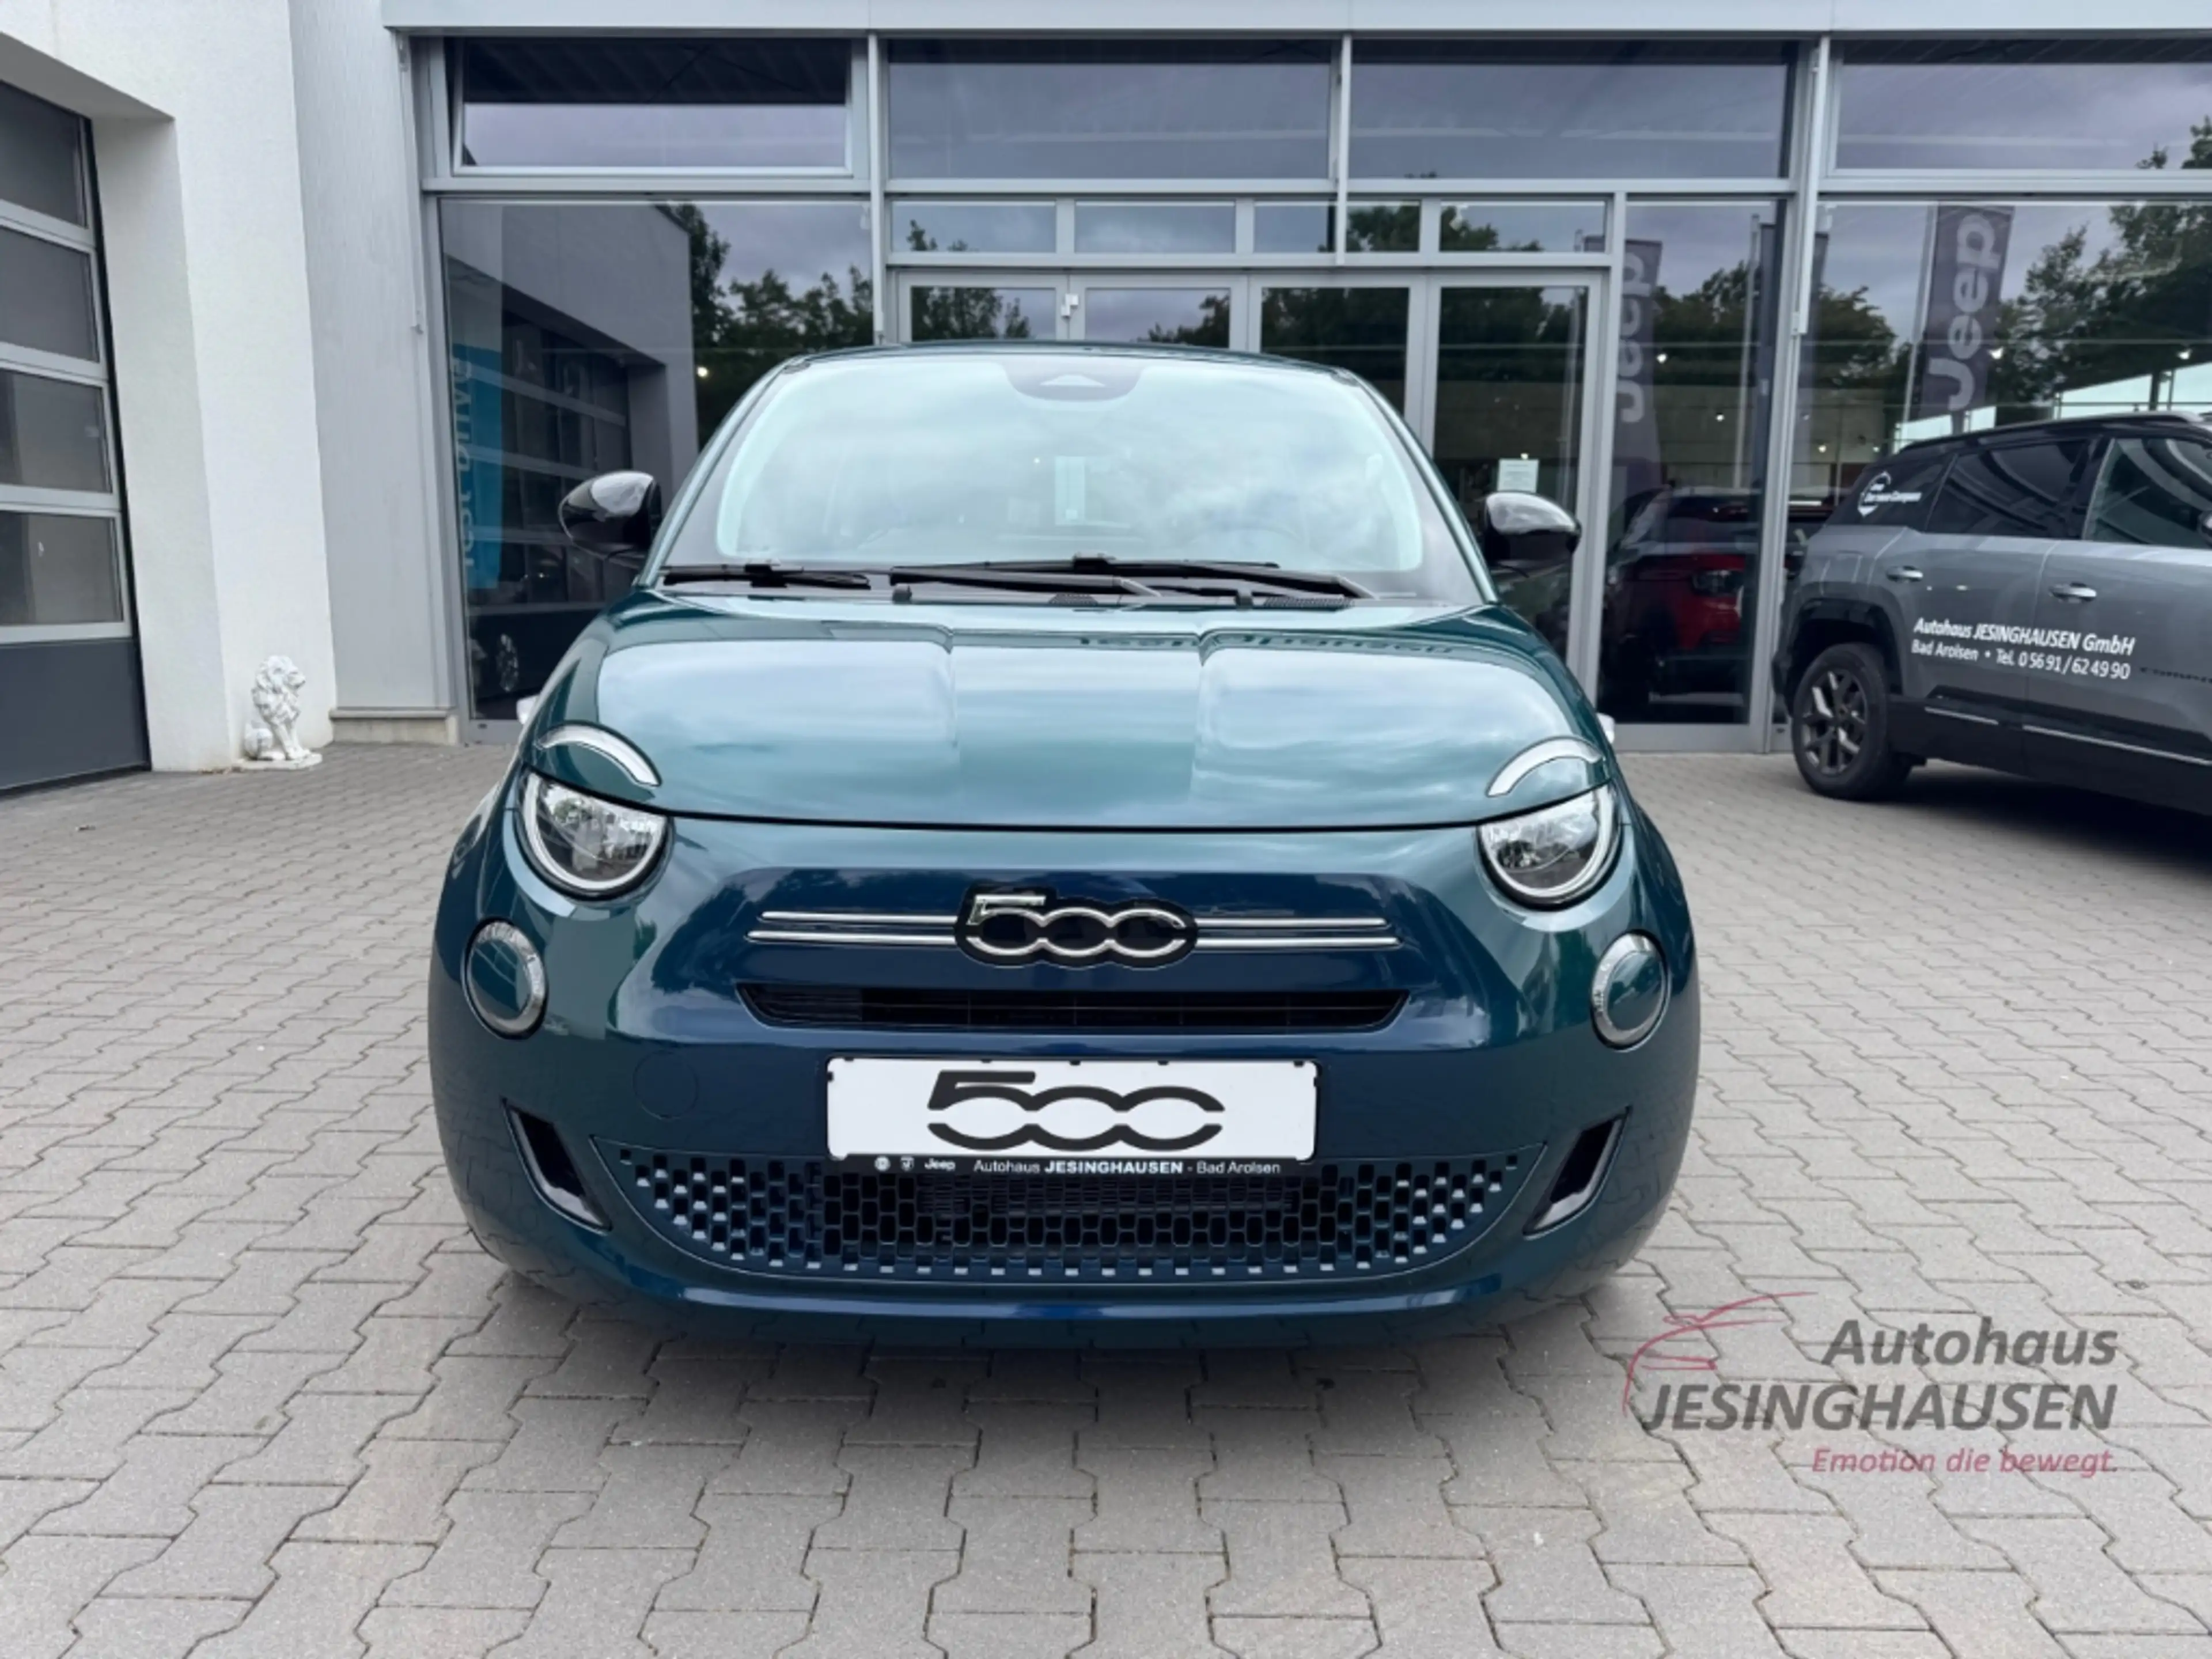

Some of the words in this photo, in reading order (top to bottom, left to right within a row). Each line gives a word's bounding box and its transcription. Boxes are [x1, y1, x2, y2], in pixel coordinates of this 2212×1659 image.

[1928, 214, 2002, 411] Jeep
[1911, 639, 1934, 656] Bad
[1913, 617, 1973, 639] Autohaus
[1972, 623, 2081, 650] JESINGHAUSEN
[2082, 633, 2135, 656] GmbH
[965, 895, 1186, 957] 500
[926, 1070, 1226, 1151] 500
[924, 1157, 956, 1171] Jeep
[974, 1160, 1040, 1173] Autohaus
[1044, 1160, 1183, 1174] JESINGHAUSEN
[1196, 1160, 1225, 1174] Bad
